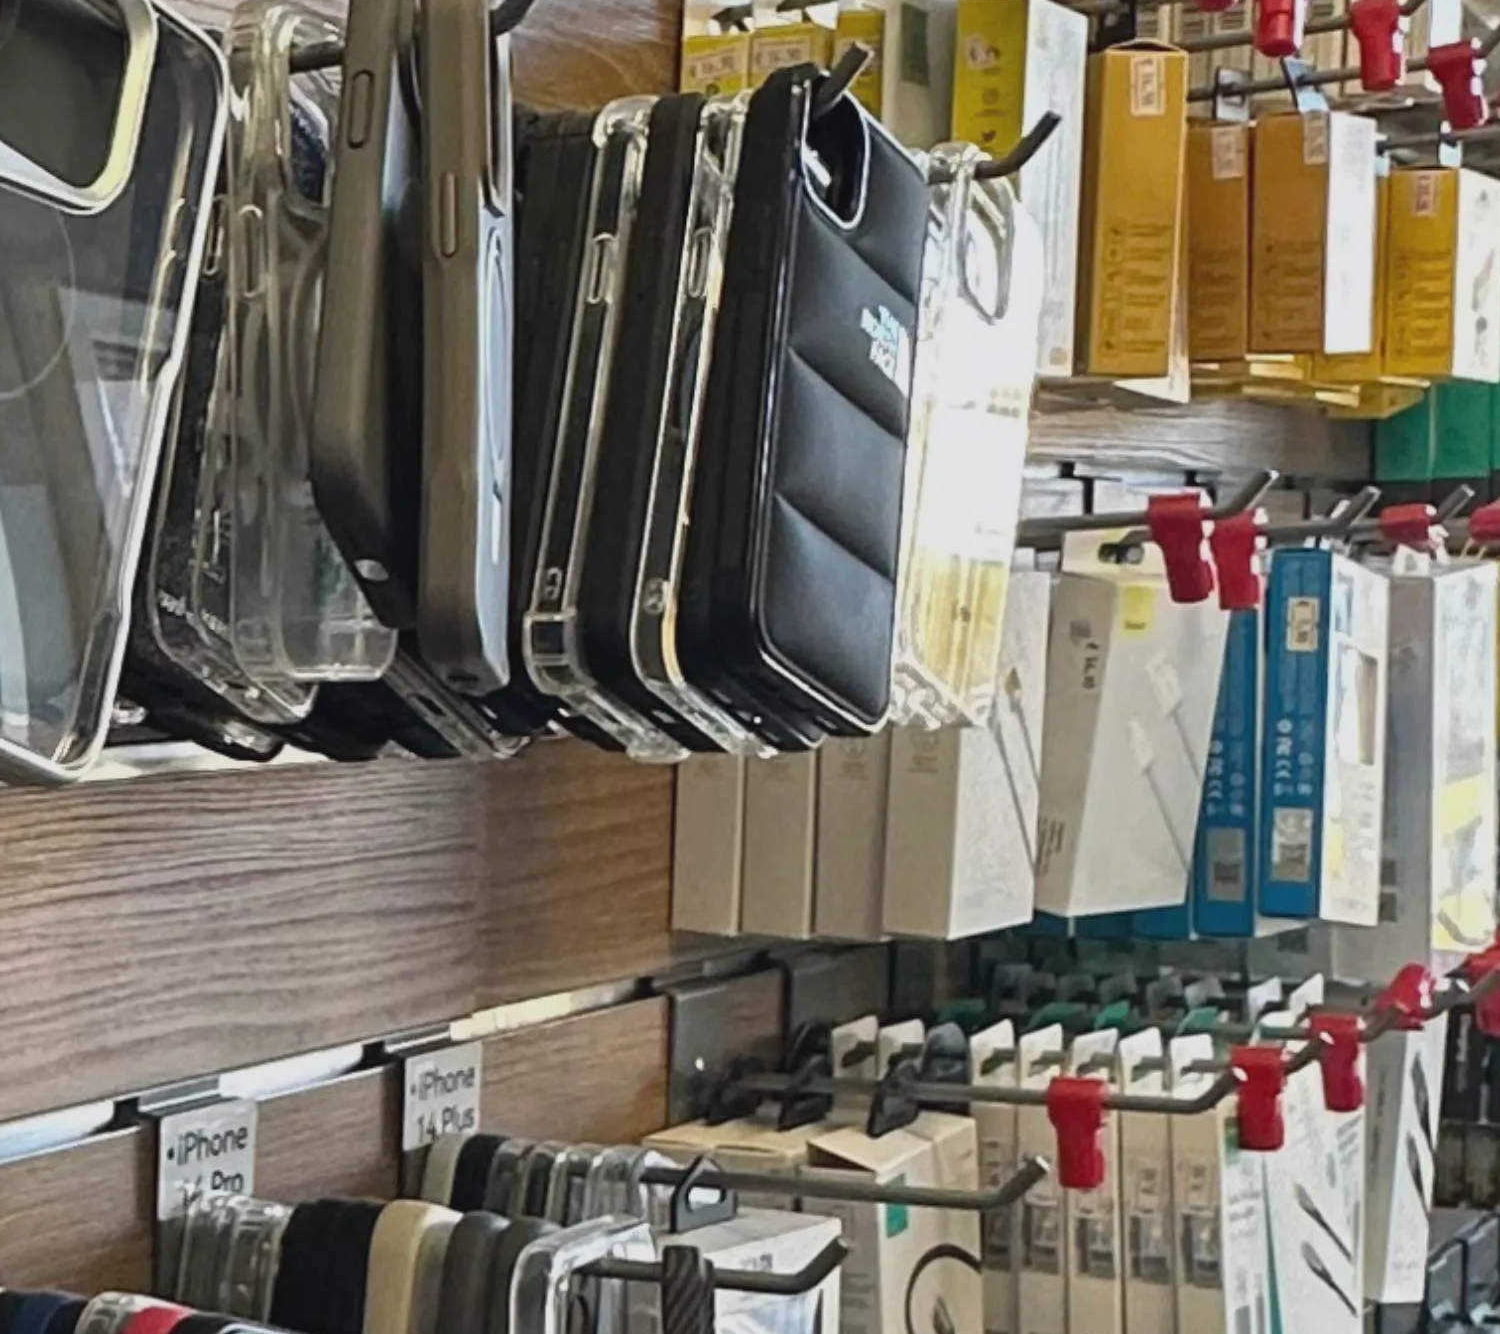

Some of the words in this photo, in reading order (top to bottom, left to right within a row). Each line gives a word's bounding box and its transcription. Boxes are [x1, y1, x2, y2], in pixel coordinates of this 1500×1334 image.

[416, 1064, 477, 1104] iPhone
[440, 1105, 476, 1138] Plus
[176, 1122, 250, 1168] iPhone
[212, 1169, 244, 1195] Pro
